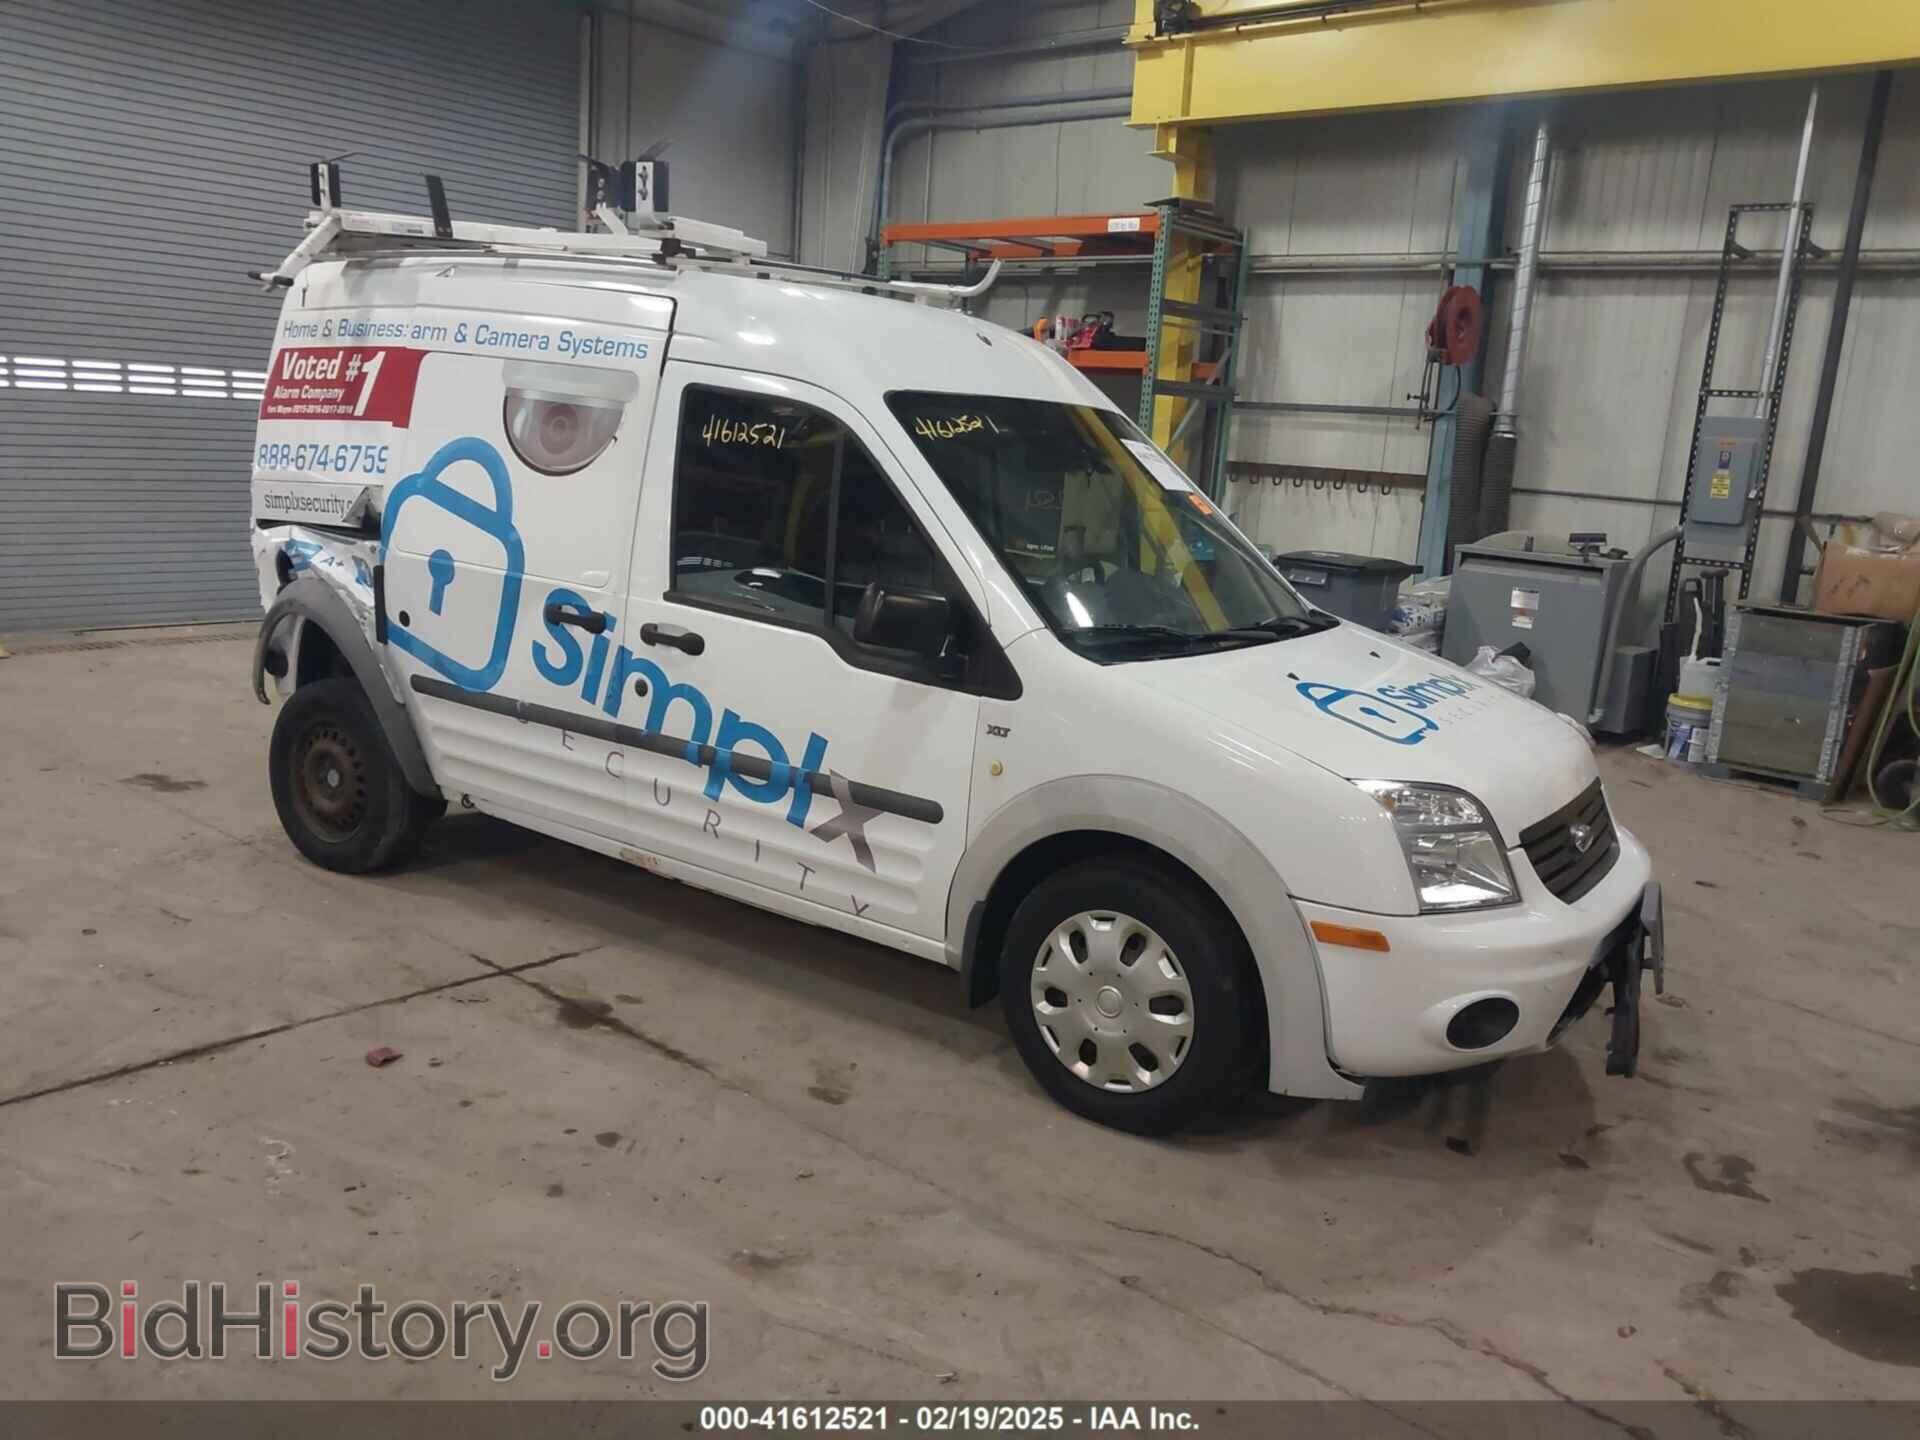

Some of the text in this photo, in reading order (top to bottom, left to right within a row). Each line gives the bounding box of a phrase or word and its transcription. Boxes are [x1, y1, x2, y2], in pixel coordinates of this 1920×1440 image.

[282, 320, 318, 338] Home
[322, 319, 333, 337] &
[454, 322, 468, 343] &
[475, 324, 550, 351] Camera
[557, 330, 649, 359] Systems
[282, 350, 344, 380] Voted
[273, 384, 345, 403] Alarm Company
[702, 413, 785, 449] 41612521
